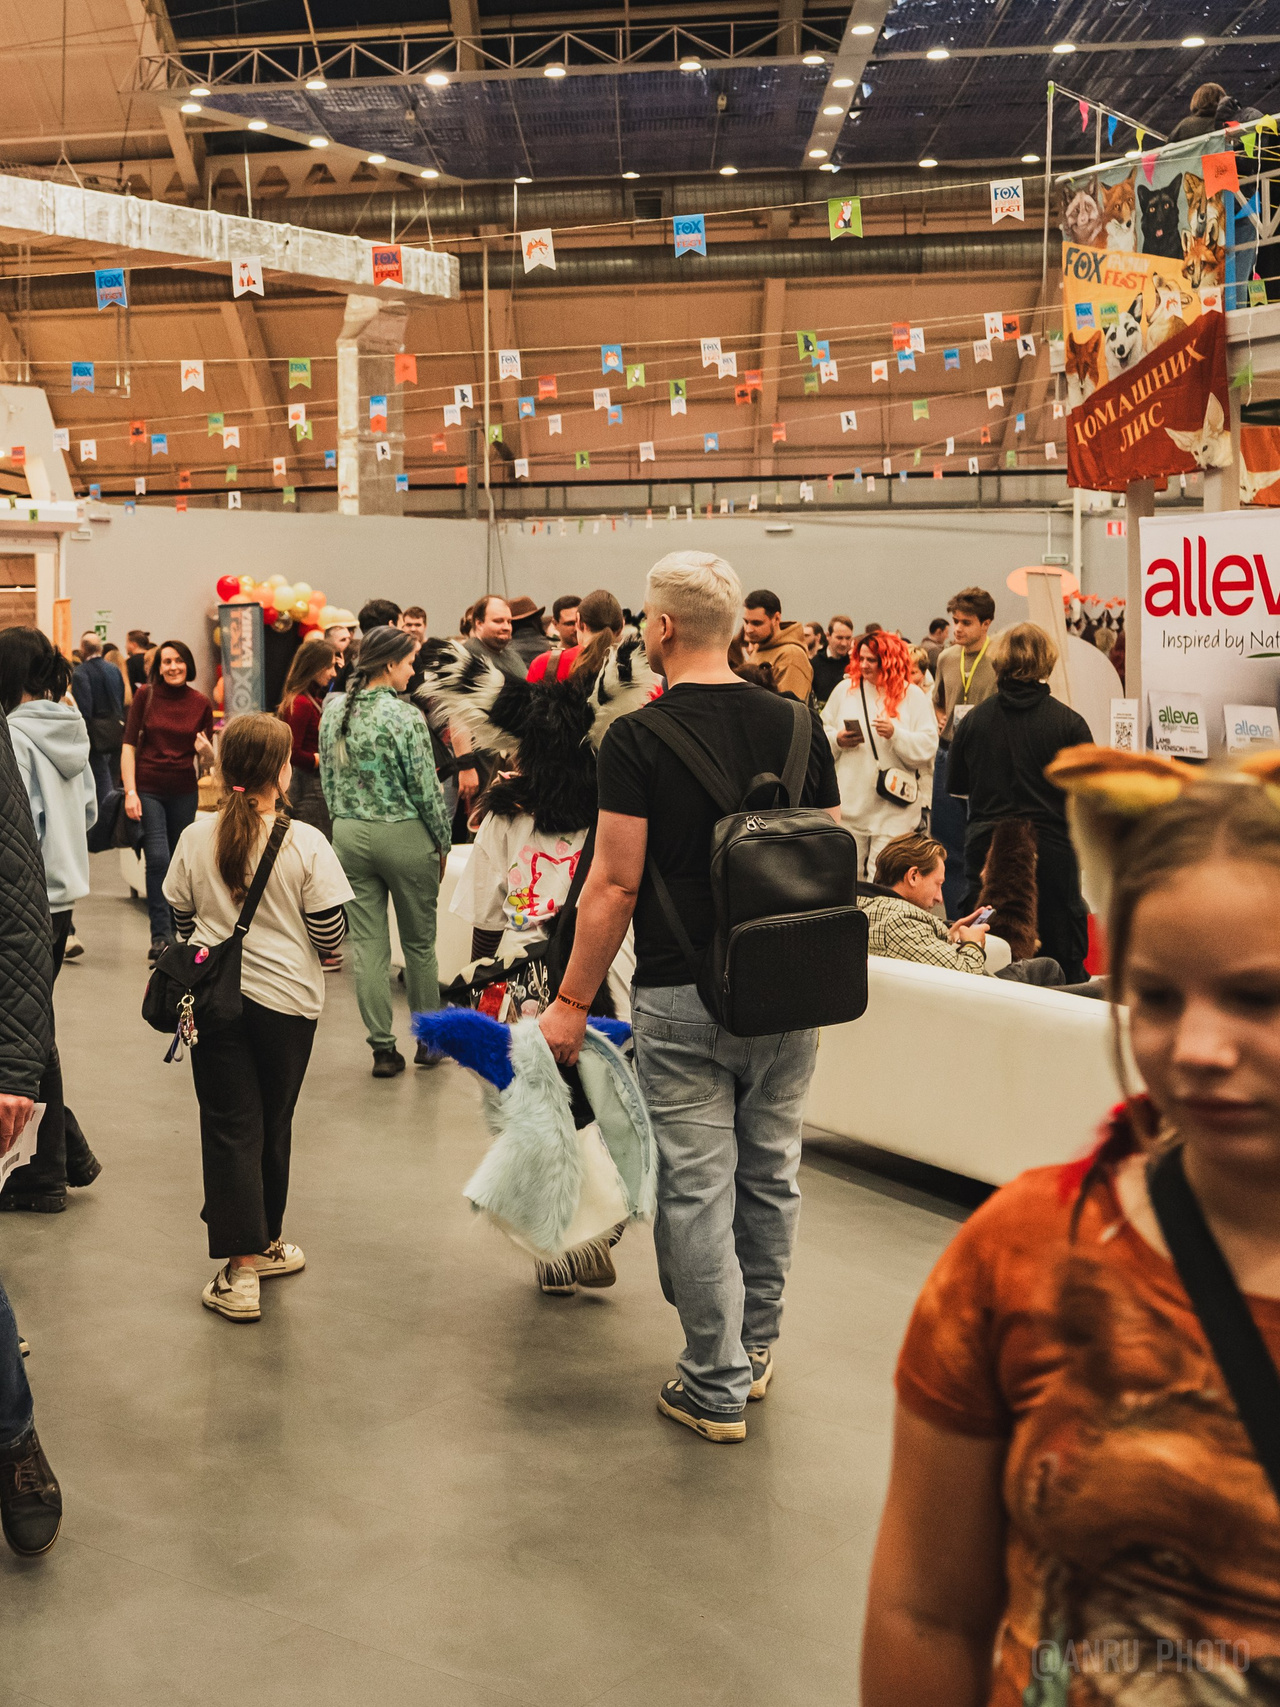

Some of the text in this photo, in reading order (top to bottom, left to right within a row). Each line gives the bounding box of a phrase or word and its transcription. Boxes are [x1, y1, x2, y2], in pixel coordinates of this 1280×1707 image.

[994, 186, 1021, 200] FOX
[676, 220, 702, 235] FOX
[375, 251, 399, 265] FOX
[1065, 247, 1107, 284] FOX
[99, 274, 123, 288] FOX
[1104, 270, 1148, 291] FEST
[1120, 401, 1165, 452] ЛИС
[1145, 535, 1280, 617] allev
[1162, 629, 1220, 654] Inspired
[1224, 628, 1244, 656] by
[1158, 705, 1199, 725] alleva
[1234, 719, 1274, 737] alleva
[1155, 737, 1171, 746] LAMB
[1160, 744, 1185, 752] VENISON
